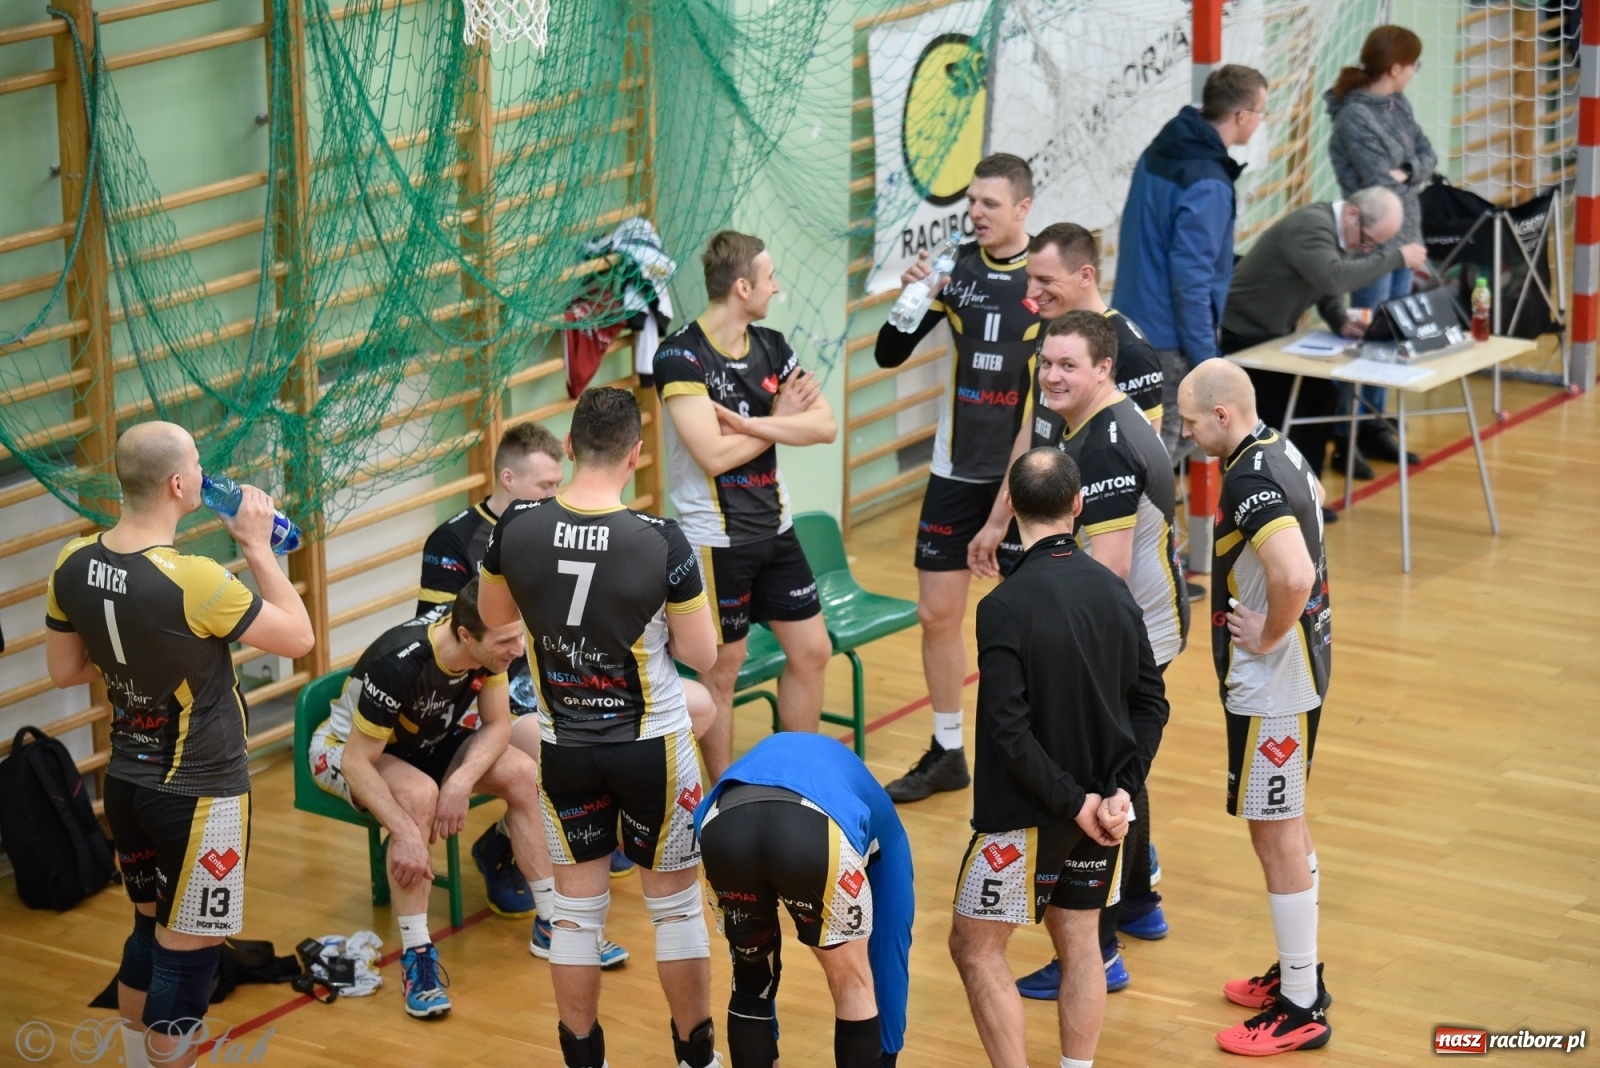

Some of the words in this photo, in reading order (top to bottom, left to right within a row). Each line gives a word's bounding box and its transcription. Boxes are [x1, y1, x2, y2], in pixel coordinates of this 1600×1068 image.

[903, 210, 976, 258] RACIBO
[983, 313, 1001, 342] 11
[972, 352, 1003, 371] ENTER
[1114, 371, 1164, 393] RAVTON
[1035, 416, 1052, 440] ENTER
[1081, 474, 1136, 497] RAVTON
[553, 521, 610, 551] ENTER
[1000, 542, 1024, 553] GRAVT
[87, 558, 128, 595] ENTER
[557, 559, 597, 627] 7
[103, 598, 127, 666] 1
[566, 636, 608, 669] Hair
[547, 671, 628, 690] INSTALMAG
[124, 678, 153, 708] Hair
[563, 696, 625, 708] GRAVTON
[1266, 741, 1286, 760] Enter
[1268, 775, 1286, 806] 2
[559, 794, 612, 819] INSTALMAG
[583, 824, 604, 846] Hair
[207, 853, 227, 872] Enter
[988, 843, 1005, 865] Enter
[1065, 859, 1107, 869] GRAVTON
[844, 874, 859, 891] Enter
[1036, 873, 1060, 882] INSTA
[200, 887, 231, 917] 13
[980, 878, 1003, 907] 5
[847, 905, 863, 929] 3
